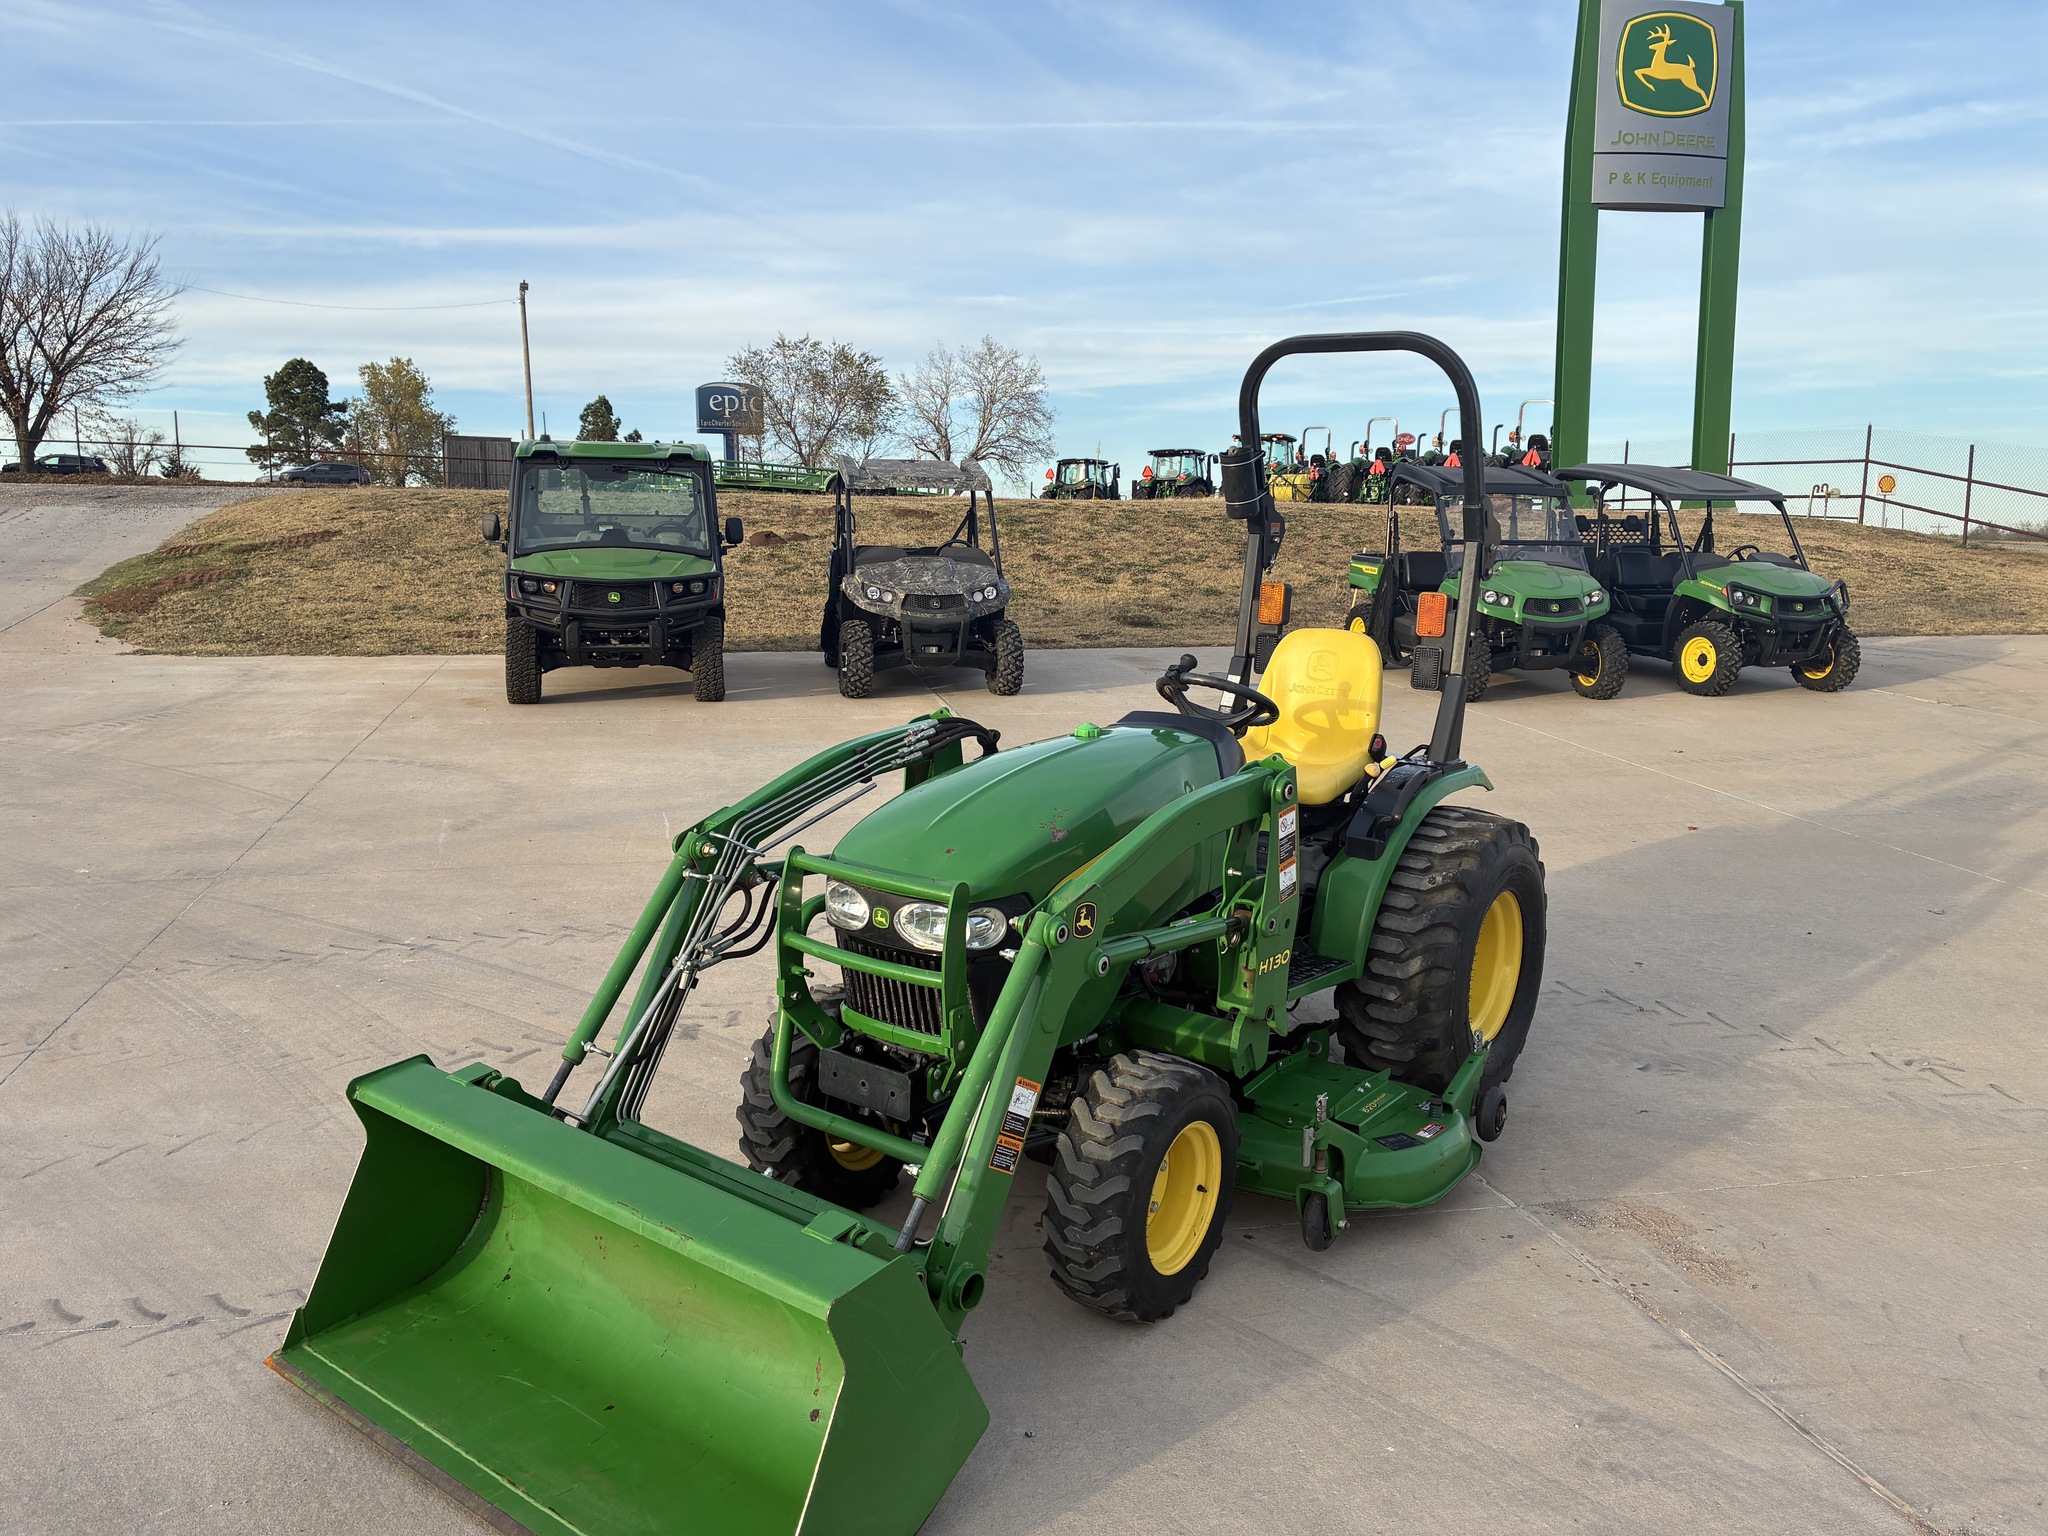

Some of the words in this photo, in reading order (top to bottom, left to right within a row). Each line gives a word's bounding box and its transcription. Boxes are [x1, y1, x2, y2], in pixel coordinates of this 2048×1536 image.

[1611, 130, 1660, 145] JOHN
[1663, 130, 1715, 148] DEERE
[1608, 172, 1618, 185] P
[1622, 172, 1633, 184] &
[1637, 172, 1647, 185] K
[1651, 172, 1714, 188] Equipment
[709, 394, 763, 418] epic
[1258, 949, 1291, 976] H130
